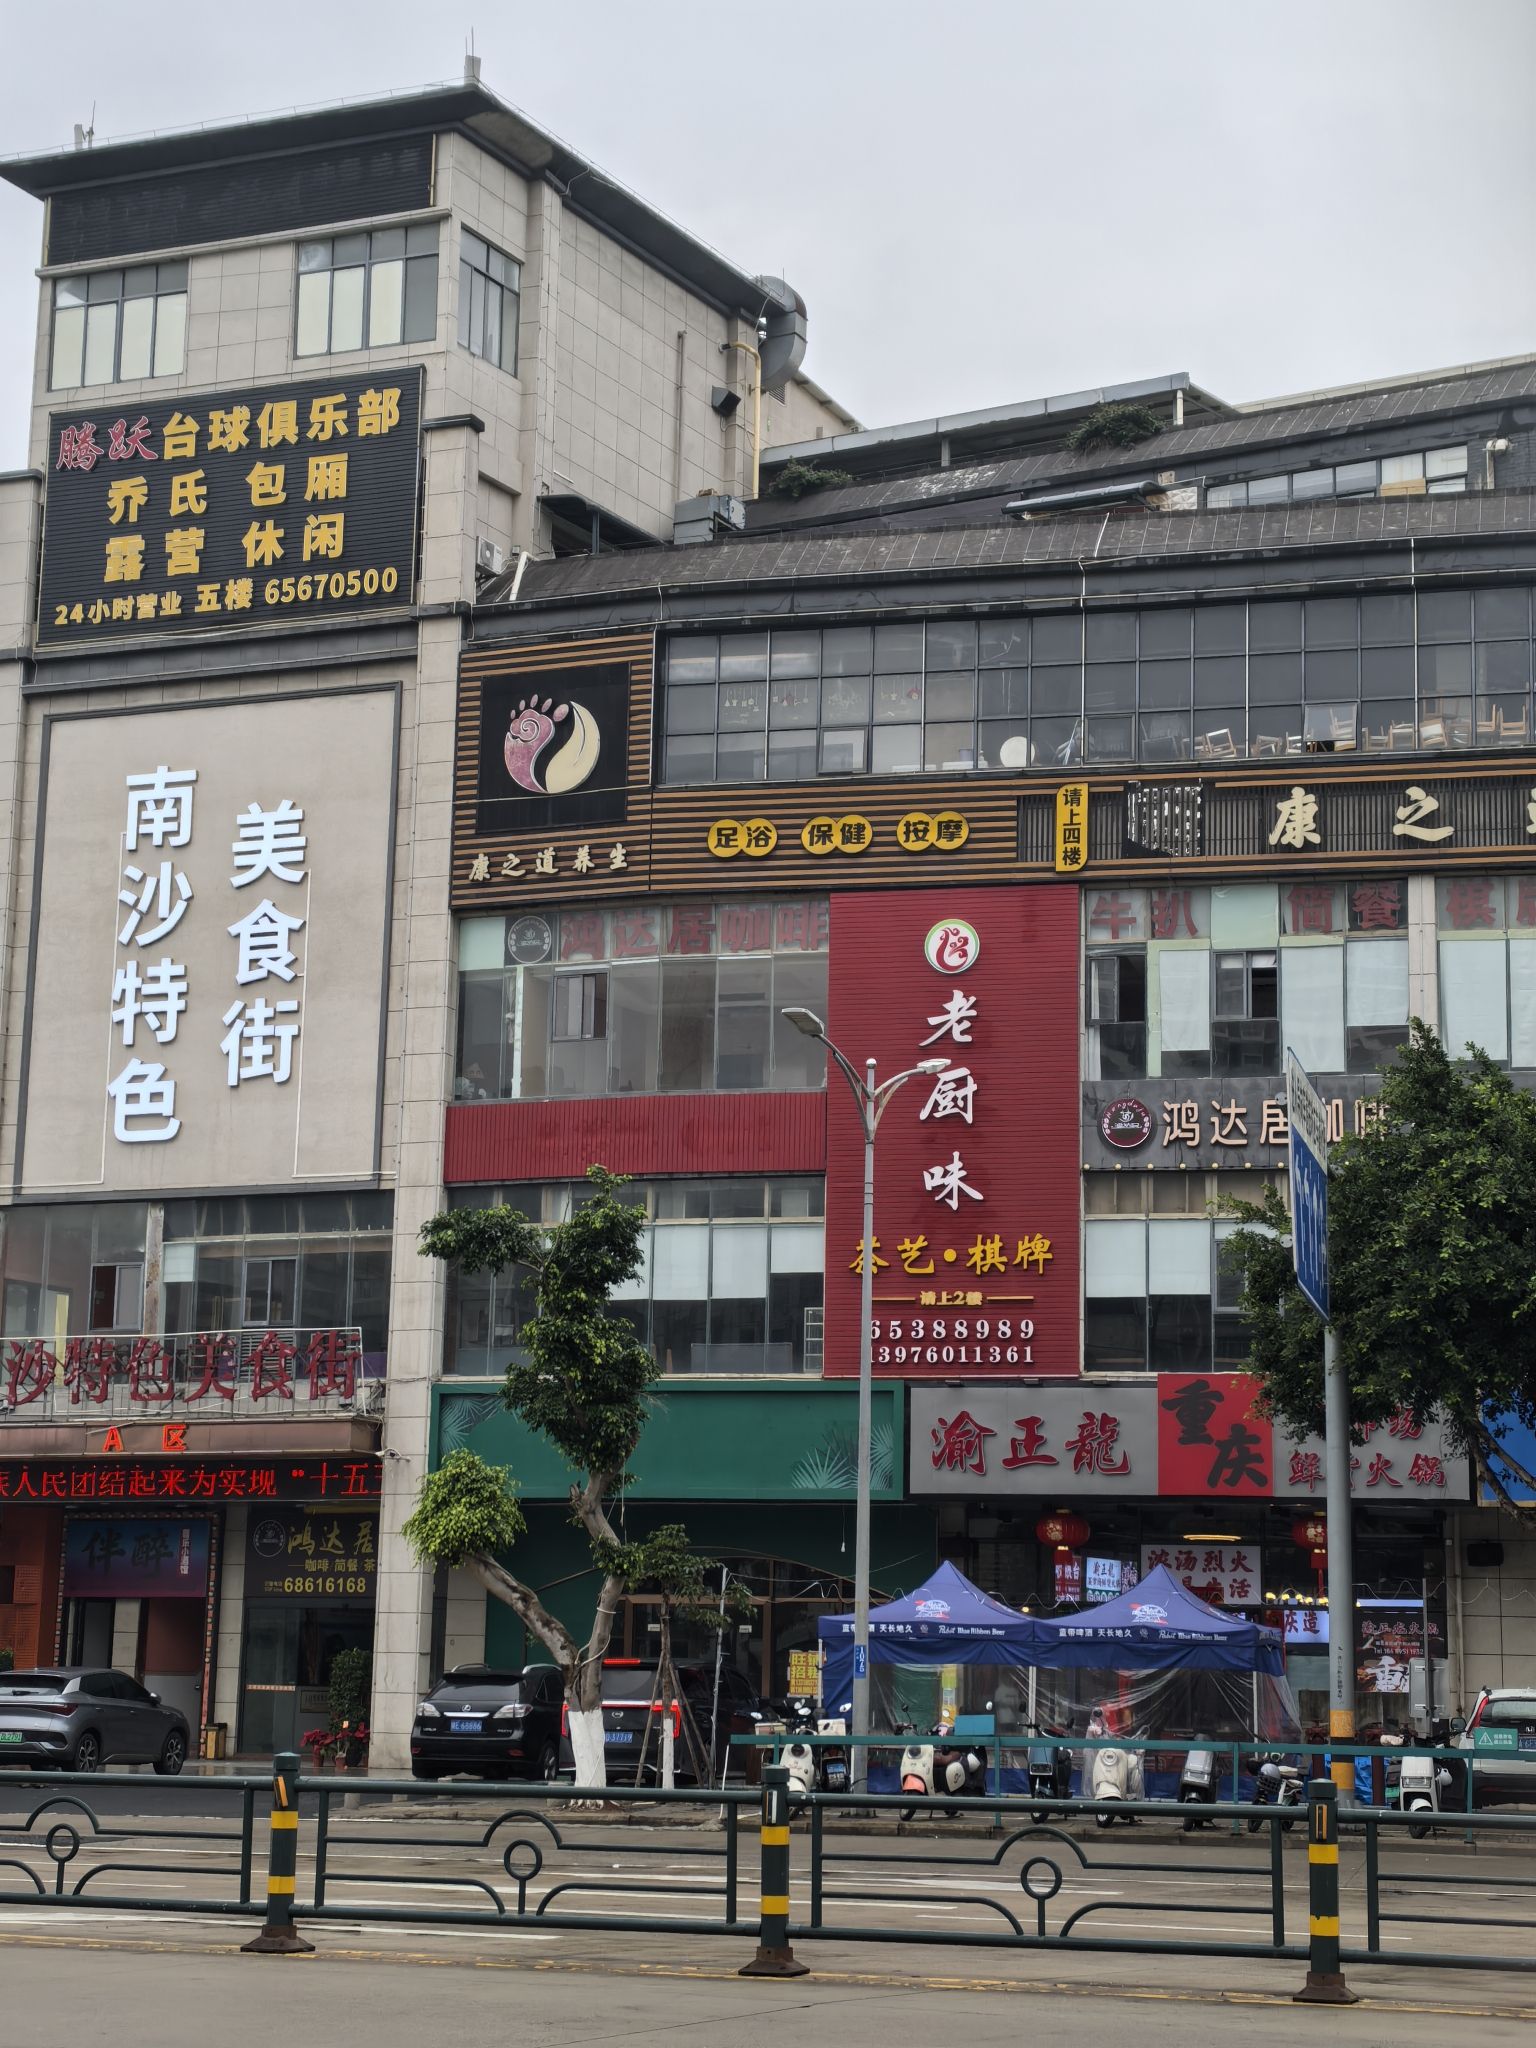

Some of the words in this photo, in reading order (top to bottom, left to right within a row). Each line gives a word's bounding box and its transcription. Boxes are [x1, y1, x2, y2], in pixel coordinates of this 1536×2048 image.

[107, 469, 208, 525] 乔氏
[244, 452, 349, 507] 包厢
[104, 526, 206, 583] 露营
[242, 512, 345, 568] 休闲
[55, 591, 182, 625] 24小时营业
[194, 578, 254, 613] 五楼
[264, 566, 398, 604] 65670500
[713, 826, 773, 849] 足浴
[807, 821, 867, 847] 保健
[903, 819, 964, 843] 按摩
[1062, 788, 1081, 867] 请上四楼
[1268, 785, 1536, 849] 康之
[468, 842, 629, 882] 康之道养生
[560, 901, 828, 962] 鸿达居咖啡
[1287, 883, 1402, 934] 简餐
[107, 765, 198, 1143] 南沙特色
[220, 799, 307, 1087] 美食街
[918, 989, 984, 1212] 老厨味
[870, 1319, 1035, 1339] 65388989
[4, 1329, 362, 1406] 沙特色美食街
[1161, 1379, 1269, 1489] 重庆
[1288, 1449, 1446, 1492] 鲜火锅
[284, 1577, 367, 1593] 68616168
